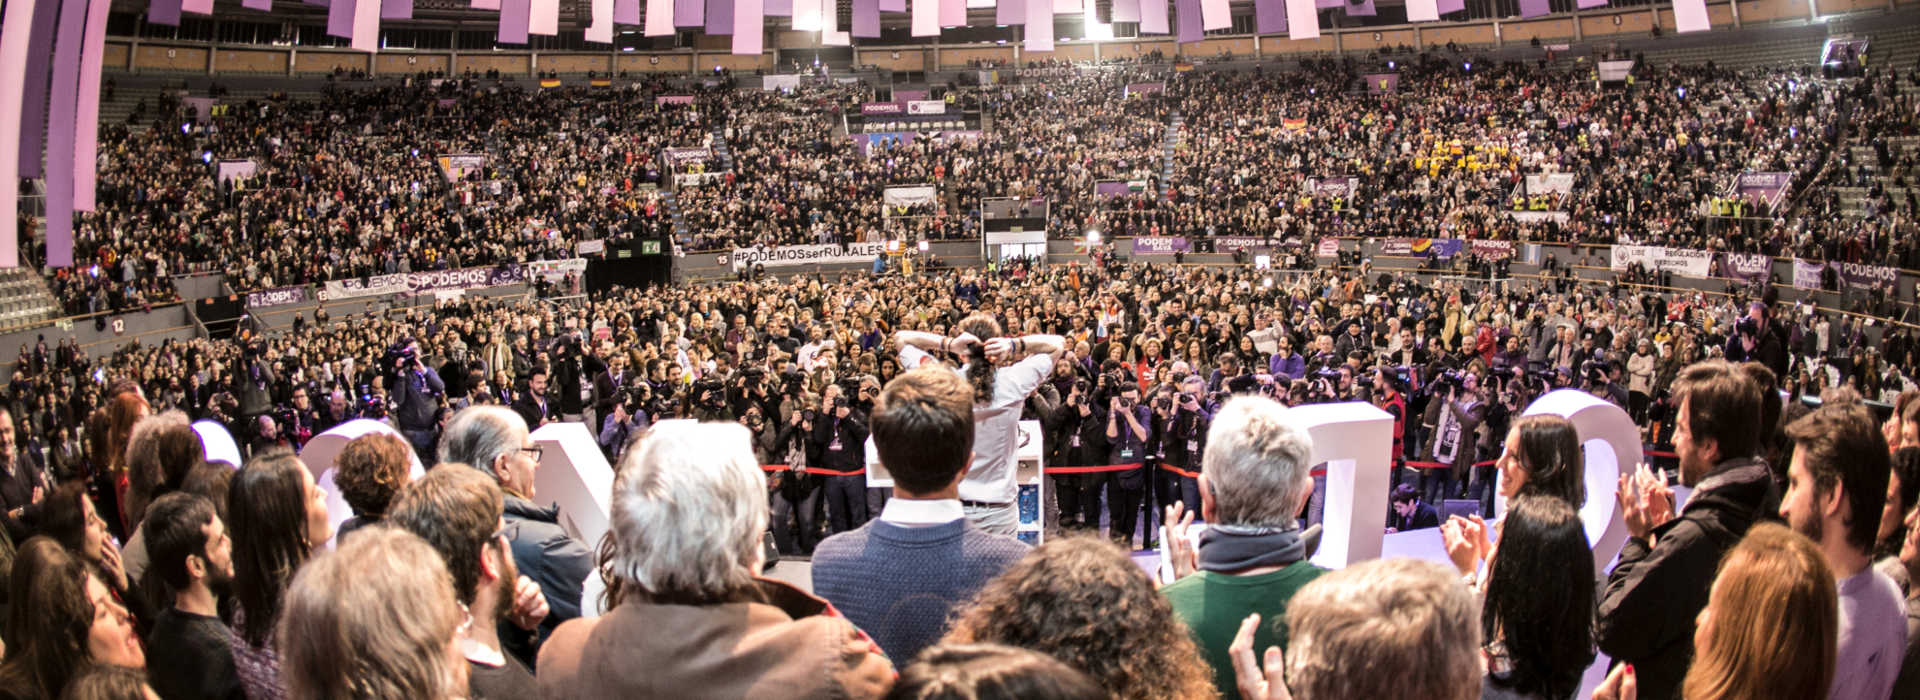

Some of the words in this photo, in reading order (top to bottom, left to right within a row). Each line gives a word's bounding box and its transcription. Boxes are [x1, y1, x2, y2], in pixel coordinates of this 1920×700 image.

[1138, 238, 1172, 246] PODEM
[1216, 238, 1256, 247] PODEMOS
[717, 255, 728, 265] 15
[734, 245, 883, 264] #PODEMOSserRURALES
[422, 269, 487, 287] PODEMOS
[112, 319, 124, 333] 12
